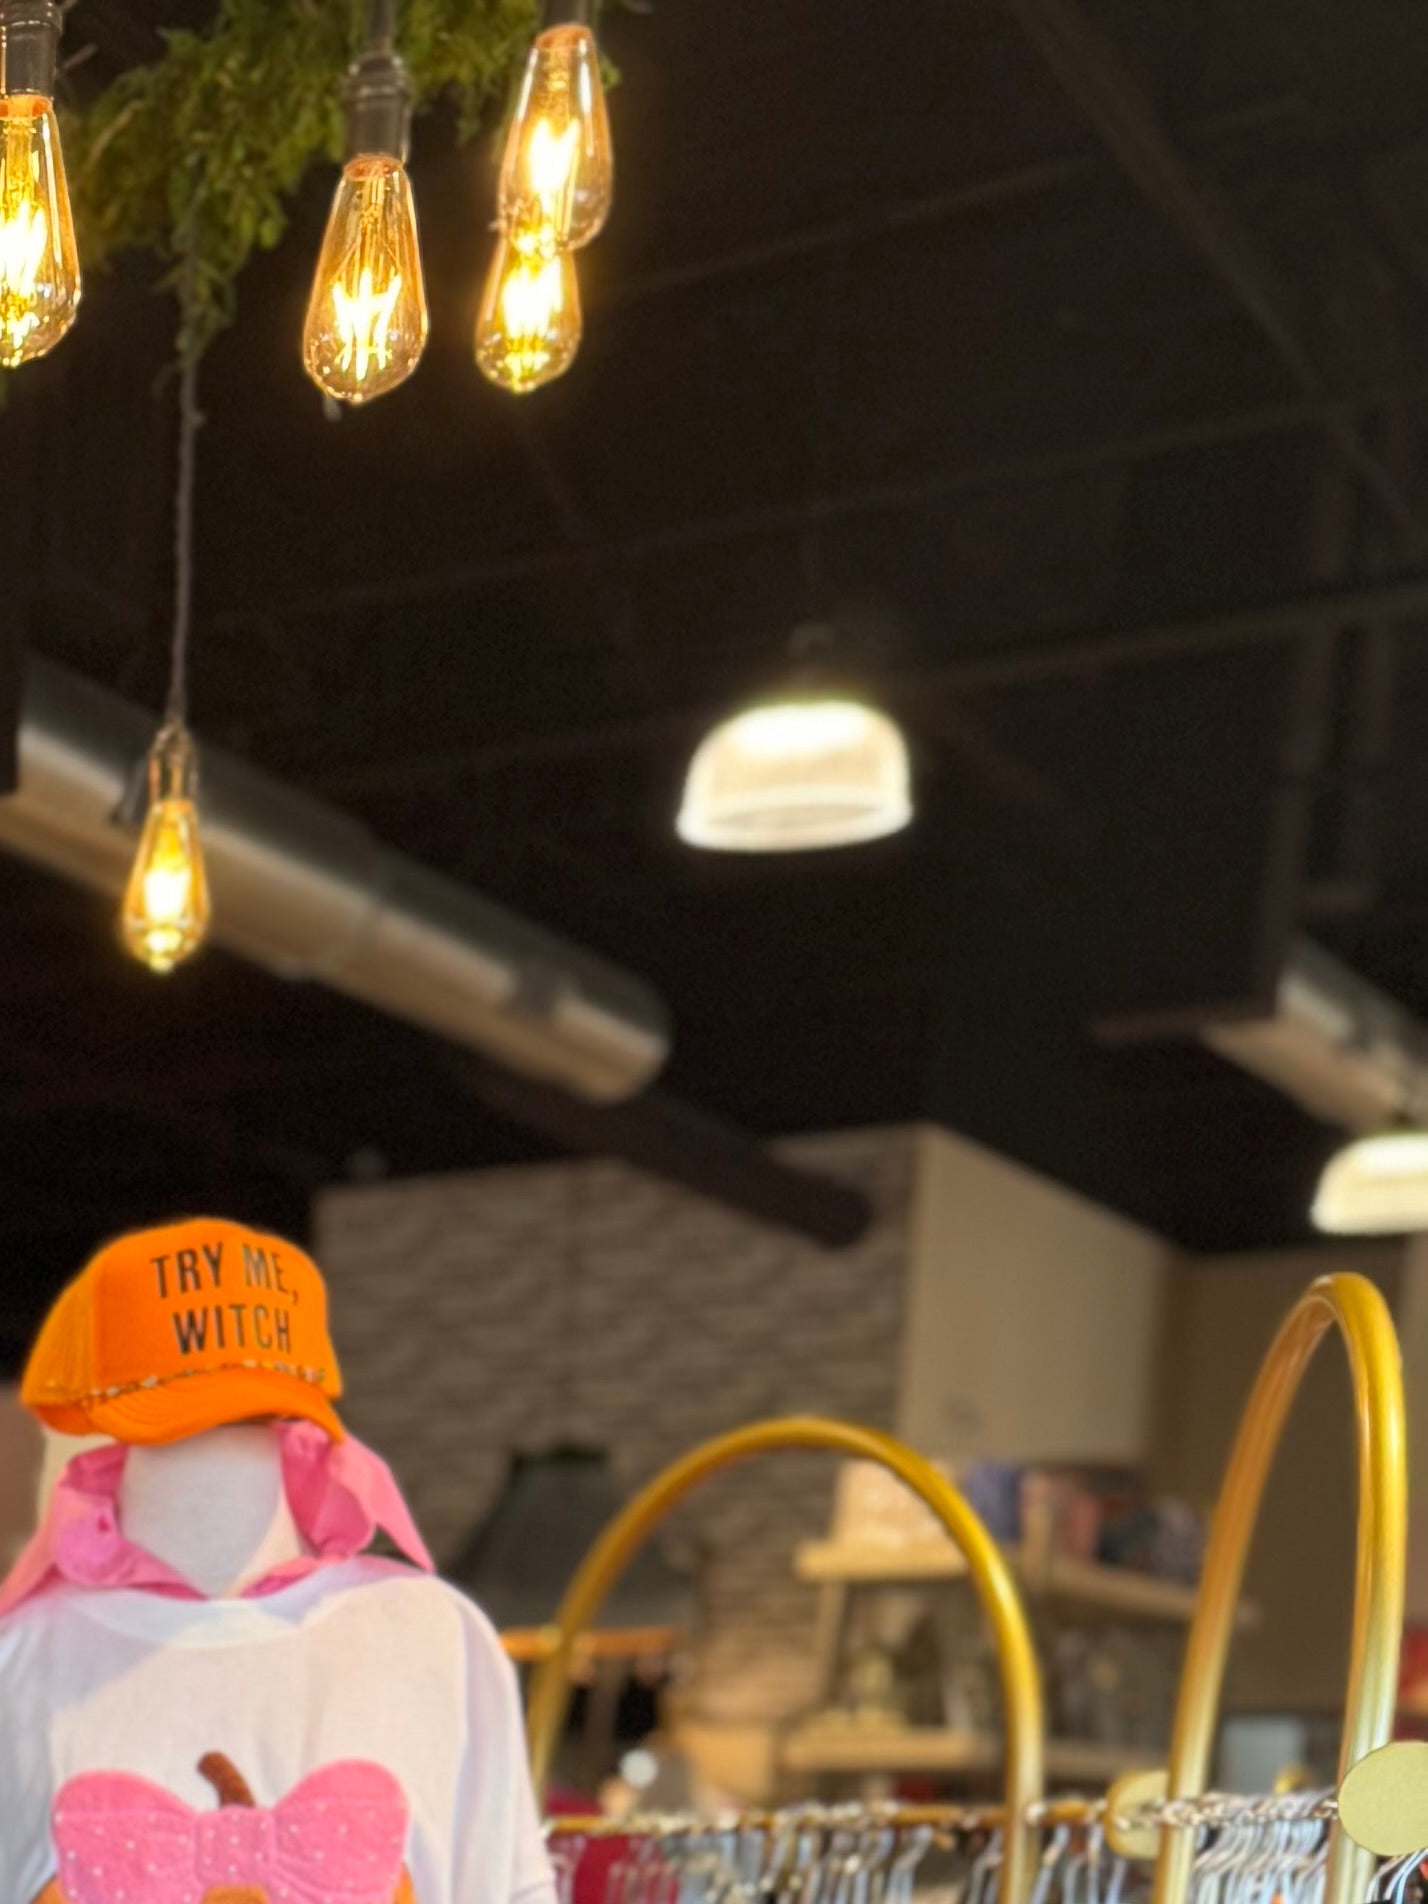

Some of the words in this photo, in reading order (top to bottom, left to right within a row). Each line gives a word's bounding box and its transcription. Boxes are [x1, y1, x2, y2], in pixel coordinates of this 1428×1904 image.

[150, 1241, 223, 1299] TRY
[242, 1243, 298, 1305] ME,
[172, 1304, 292, 1355] WITCH
